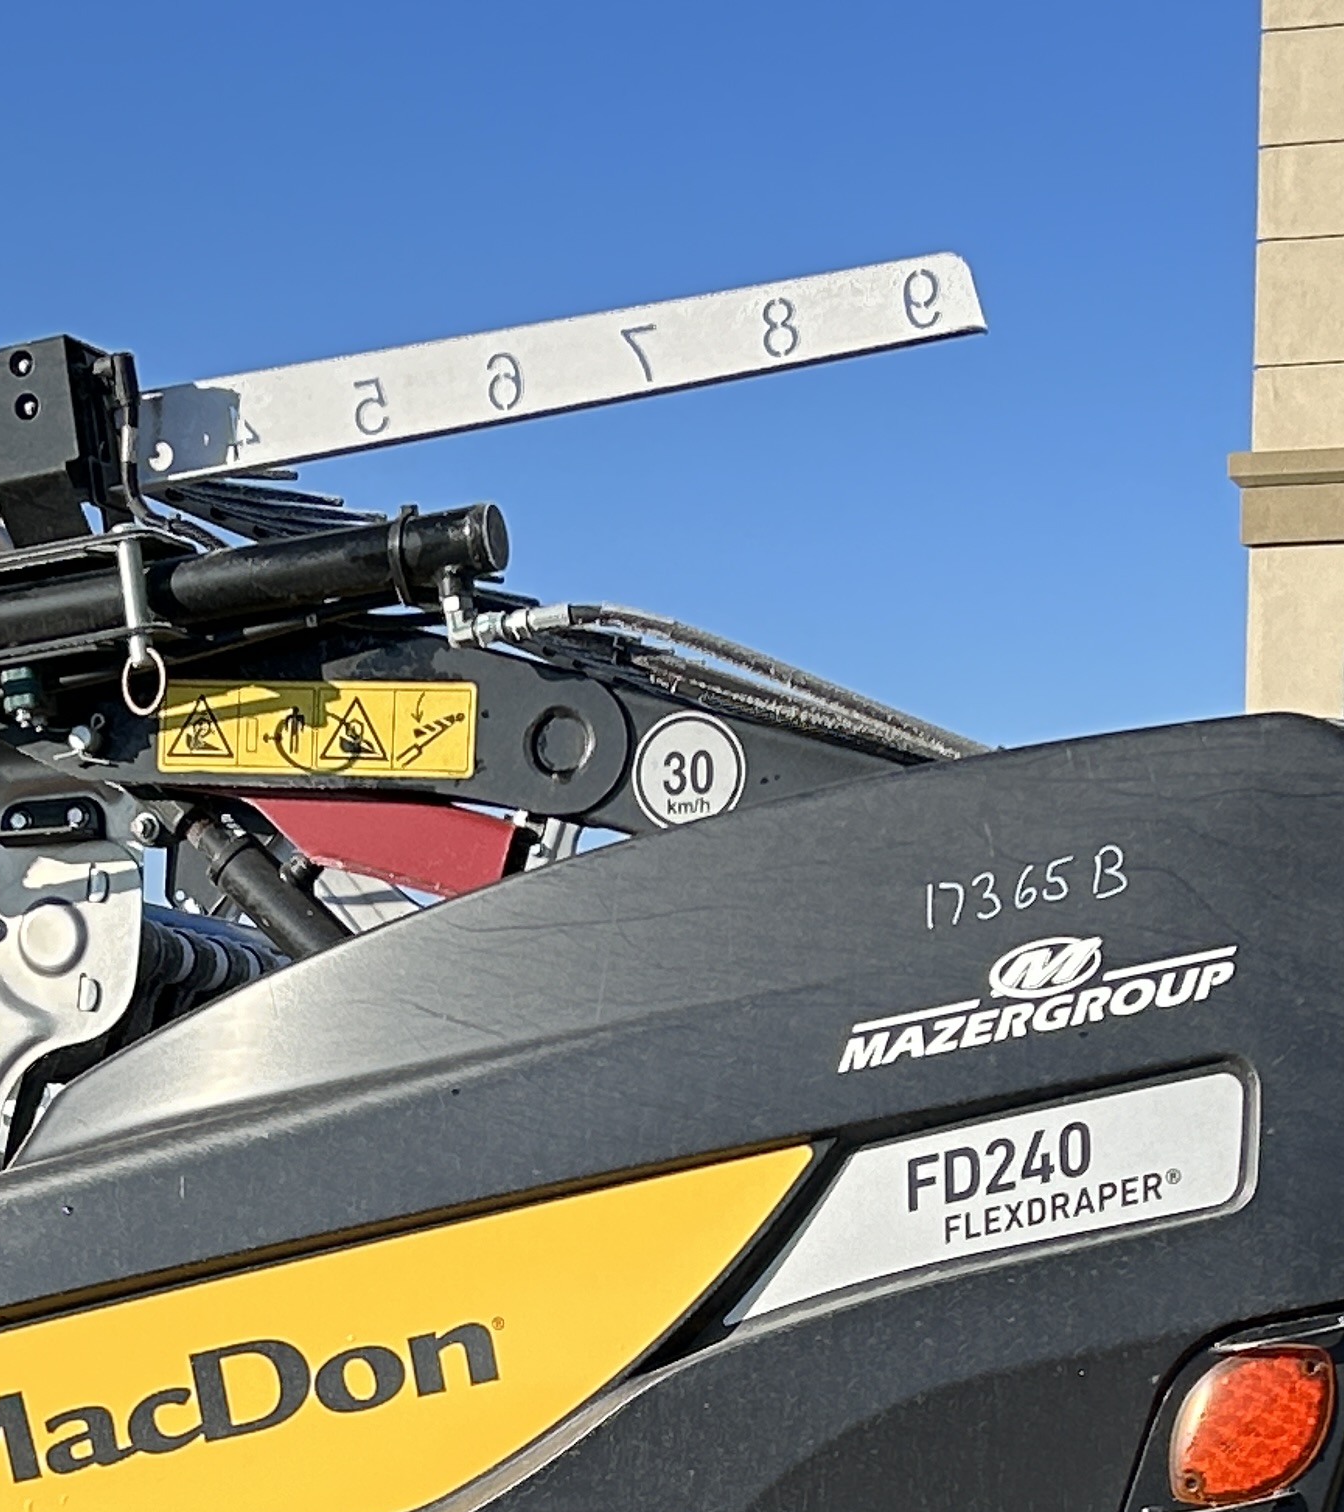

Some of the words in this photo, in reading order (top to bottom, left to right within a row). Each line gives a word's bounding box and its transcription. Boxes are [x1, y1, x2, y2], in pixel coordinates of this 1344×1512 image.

[663, 749, 714, 796] 30
[667, 797, 711, 815] km/h
[837, 961, 1236, 1074] MAZERGROUP
[906, 1120, 1092, 1213] FD240
